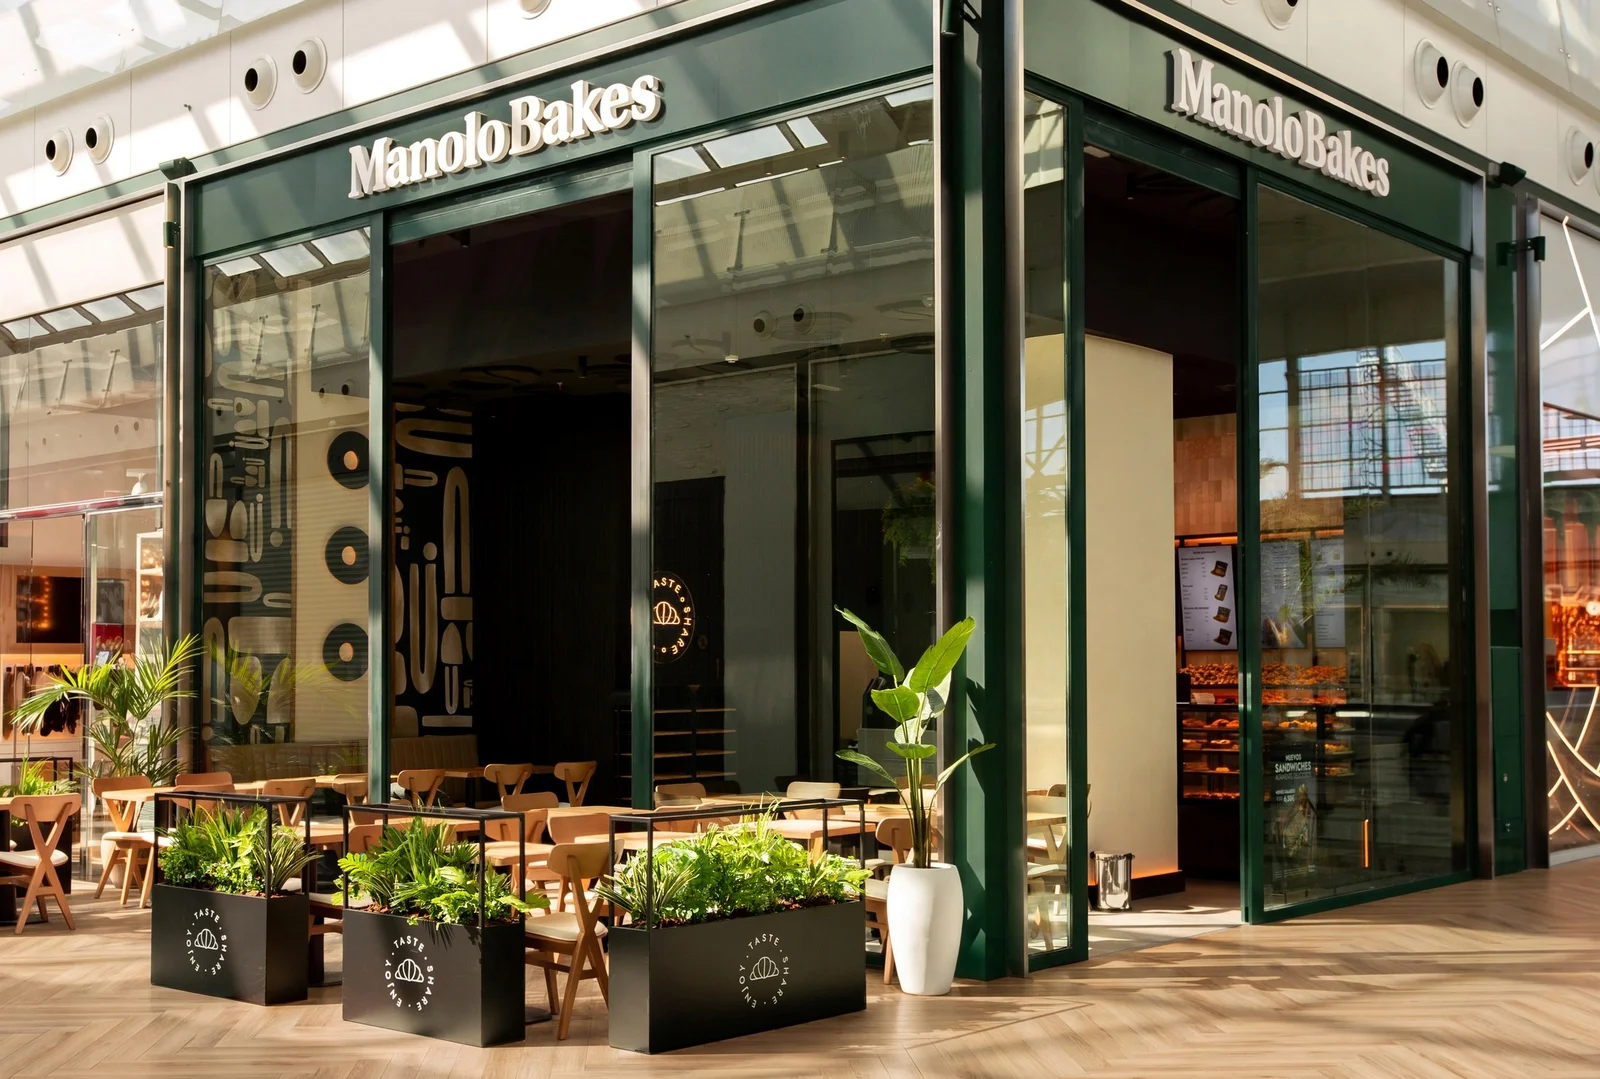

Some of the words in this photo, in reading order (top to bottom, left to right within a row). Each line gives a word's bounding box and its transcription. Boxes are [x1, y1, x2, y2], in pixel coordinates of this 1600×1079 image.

[348, 75, 662, 199] ManoloBakes
[1172, 48, 1390, 197] ManoloBakes
[653, 577, 682, 594] ASTE
[671, 606, 692, 655] SHARE
[1275, 761, 1312, 773] SANDWICHES
[1285, 753, 1302, 761] NUEVOS
[194, 908, 220, 923] TASTE
[186, 929, 200, 972] ENJOY
[211, 934, 227, 976] SHARE
[393, 935, 425, 953] TASTE
[748, 933, 780, 950] TASTE
[385, 959, 402, 1008] ENJOY
[416, 965, 435, 1011] SHARE
[739, 964, 757, 1009] ENJOY
[772, 956, 790, 1005] SHARE
